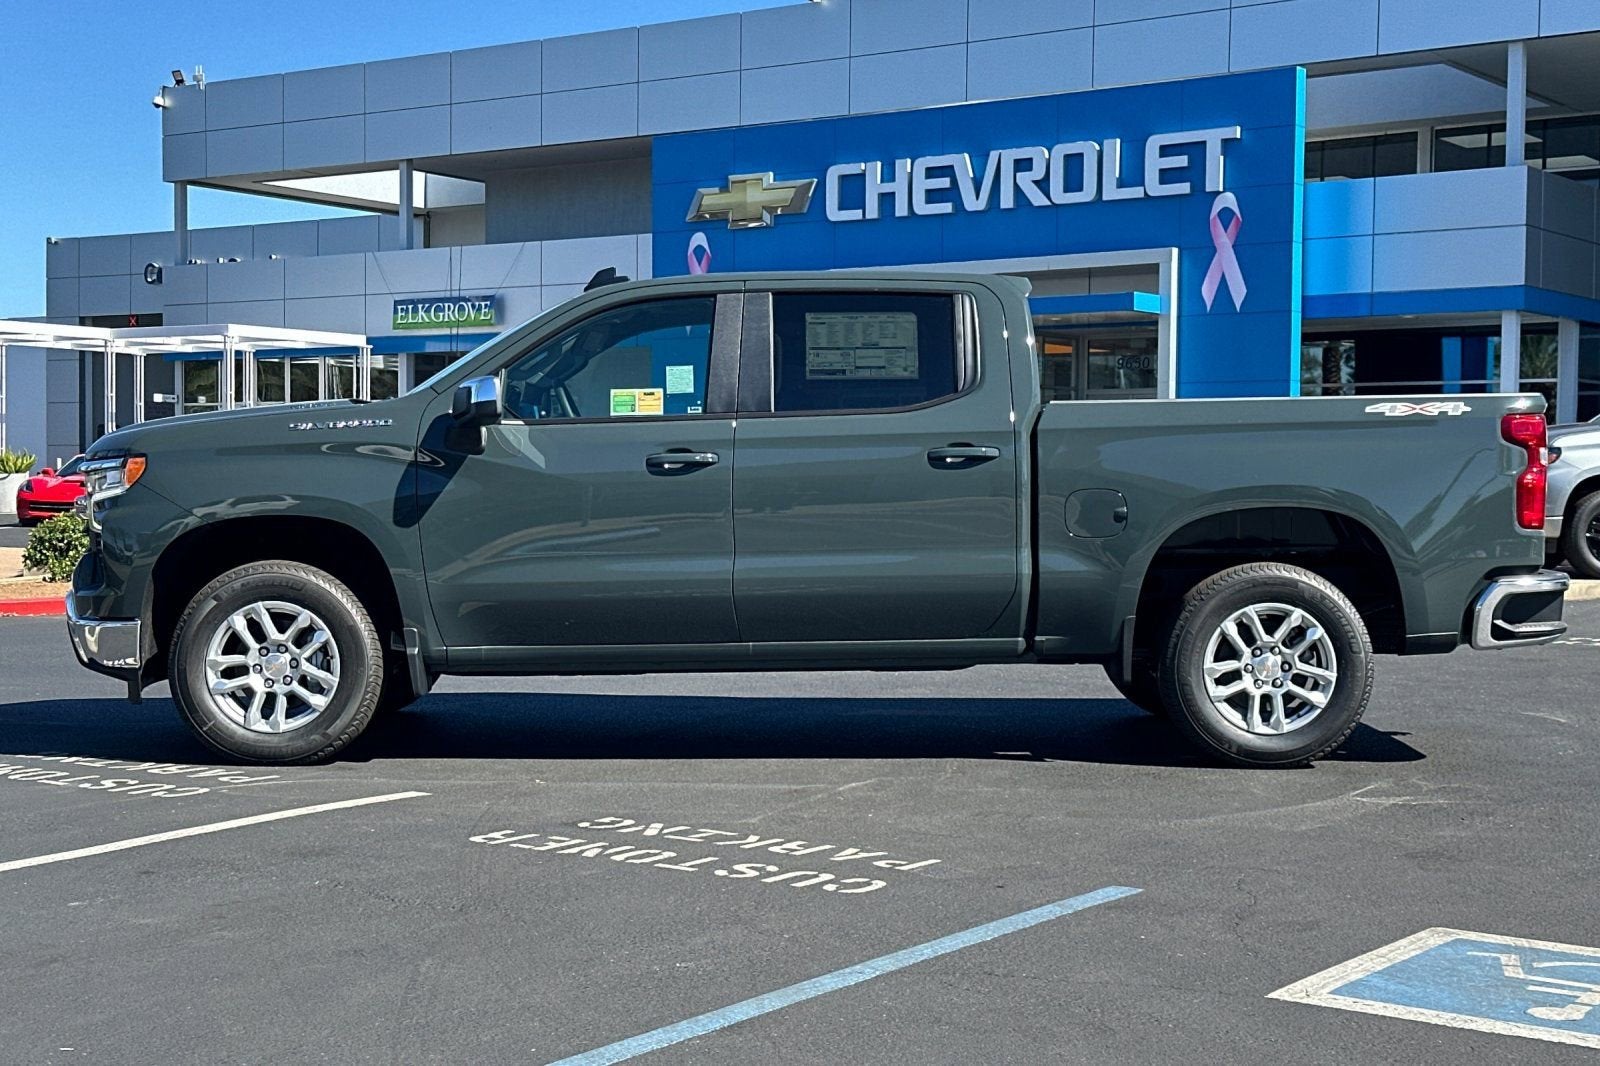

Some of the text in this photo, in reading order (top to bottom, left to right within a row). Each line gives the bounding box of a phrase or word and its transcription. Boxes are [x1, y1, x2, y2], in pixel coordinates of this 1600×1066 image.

[826, 126, 1241, 222] CHEVROLET
[469, 830, 887, 894] CUSTOMER
[577, 816, 942, 871] PARKING
